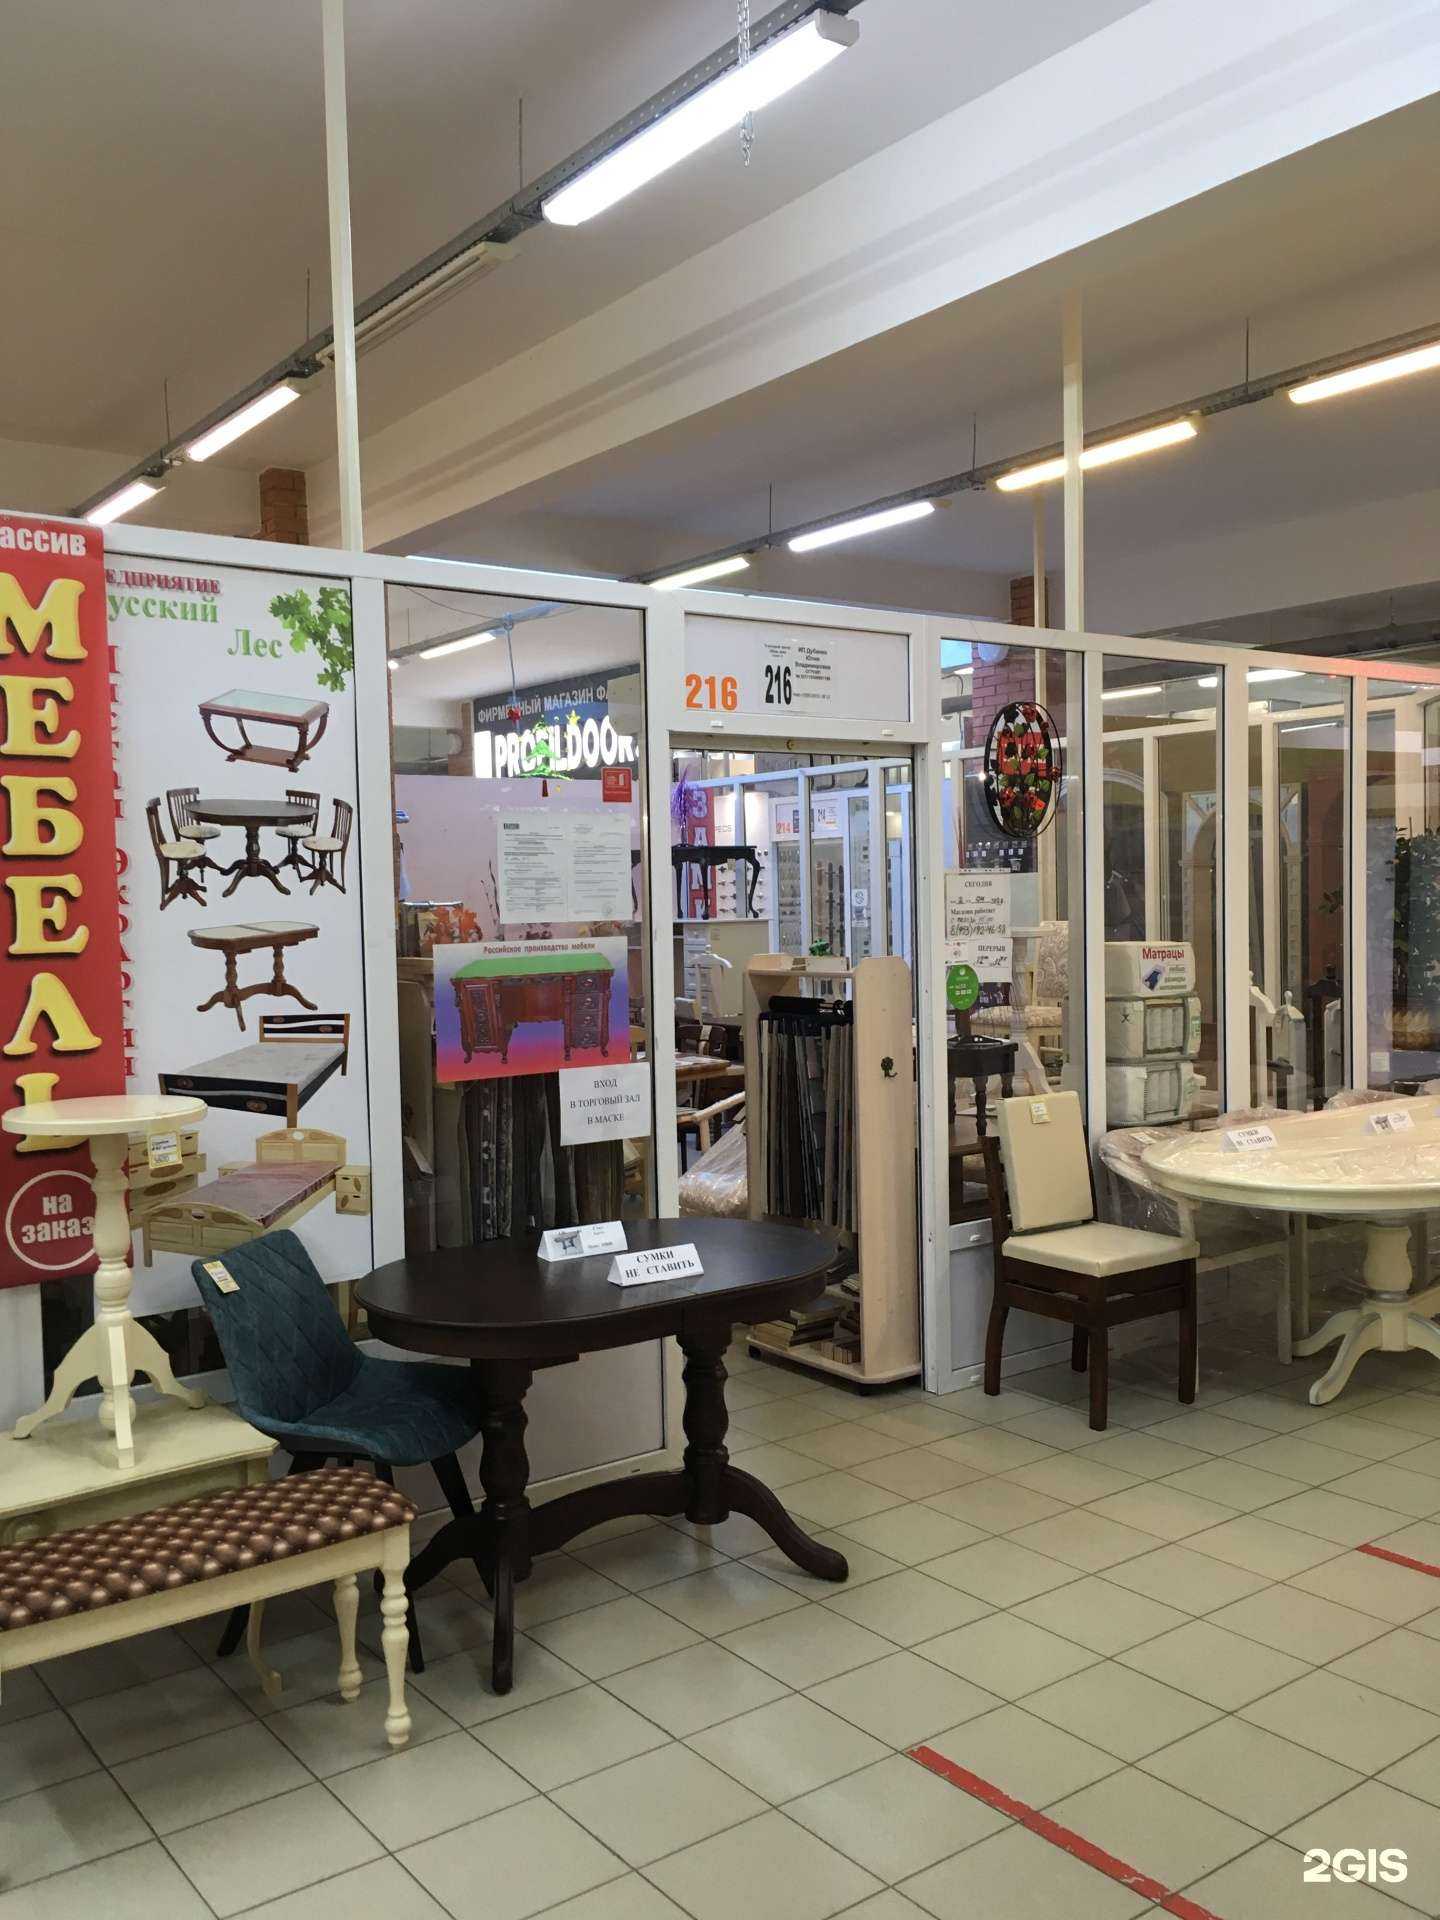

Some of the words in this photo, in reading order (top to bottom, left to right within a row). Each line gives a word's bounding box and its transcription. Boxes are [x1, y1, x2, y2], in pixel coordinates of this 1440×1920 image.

[0, 526, 87, 556] ассив
[227, 627, 284, 659] Лес
[685, 673, 738, 711] 216
[764, 664, 793, 706] 216
[544, 687, 594, 712] МАГАЗИН
[1142, 948, 1185, 961] Матрацы
[593, 1078, 618, 1089] ВХОД
[578, 1094, 623, 1108] ТОРГОВЫЙ
[625, 1094, 641, 1104] ЗАЛ
[594, 1112, 625, 1124] МАСКЕ
[21, 1216, 94, 1245] заказ
[636, 1250, 675, 1264] СУМКИ
[625, 1268, 640, 1279] НЕ
[646, 1259, 695, 1276] СТАВИТЬ
